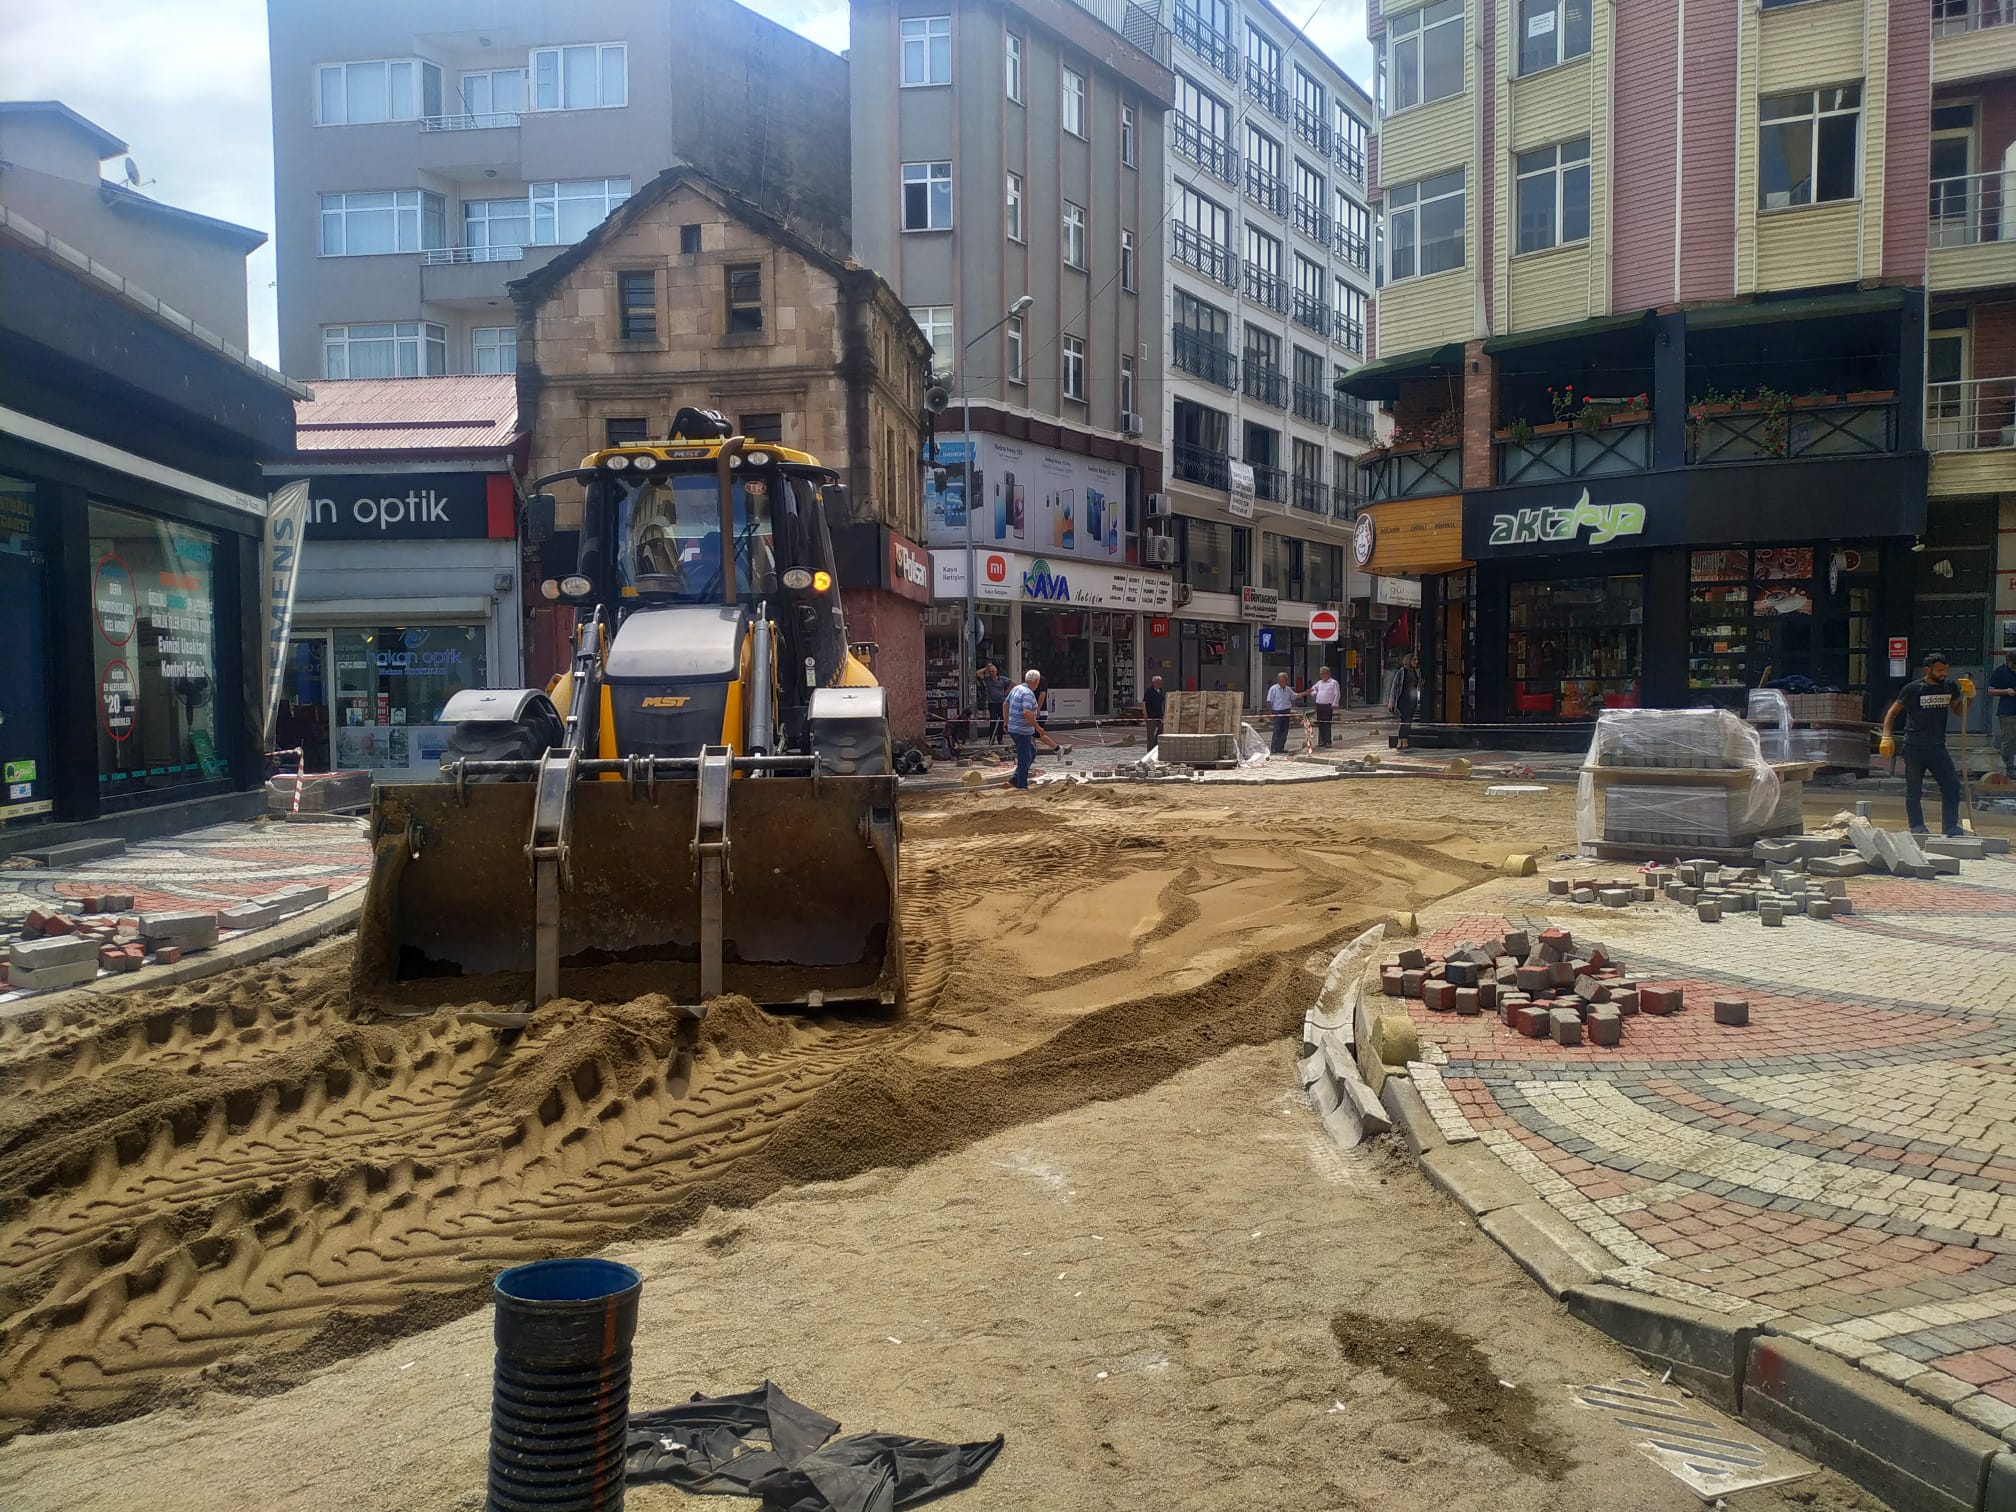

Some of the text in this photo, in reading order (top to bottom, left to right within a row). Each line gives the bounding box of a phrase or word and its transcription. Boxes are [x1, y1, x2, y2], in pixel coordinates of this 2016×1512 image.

[353, 490, 449, 530] optik
[943, 566, 957, 574] Kaya
[1023, 571, 1070, 601] KAYA
[161, 660, 185, 677] Kontrol
[641, 696, 691, 708] MST
